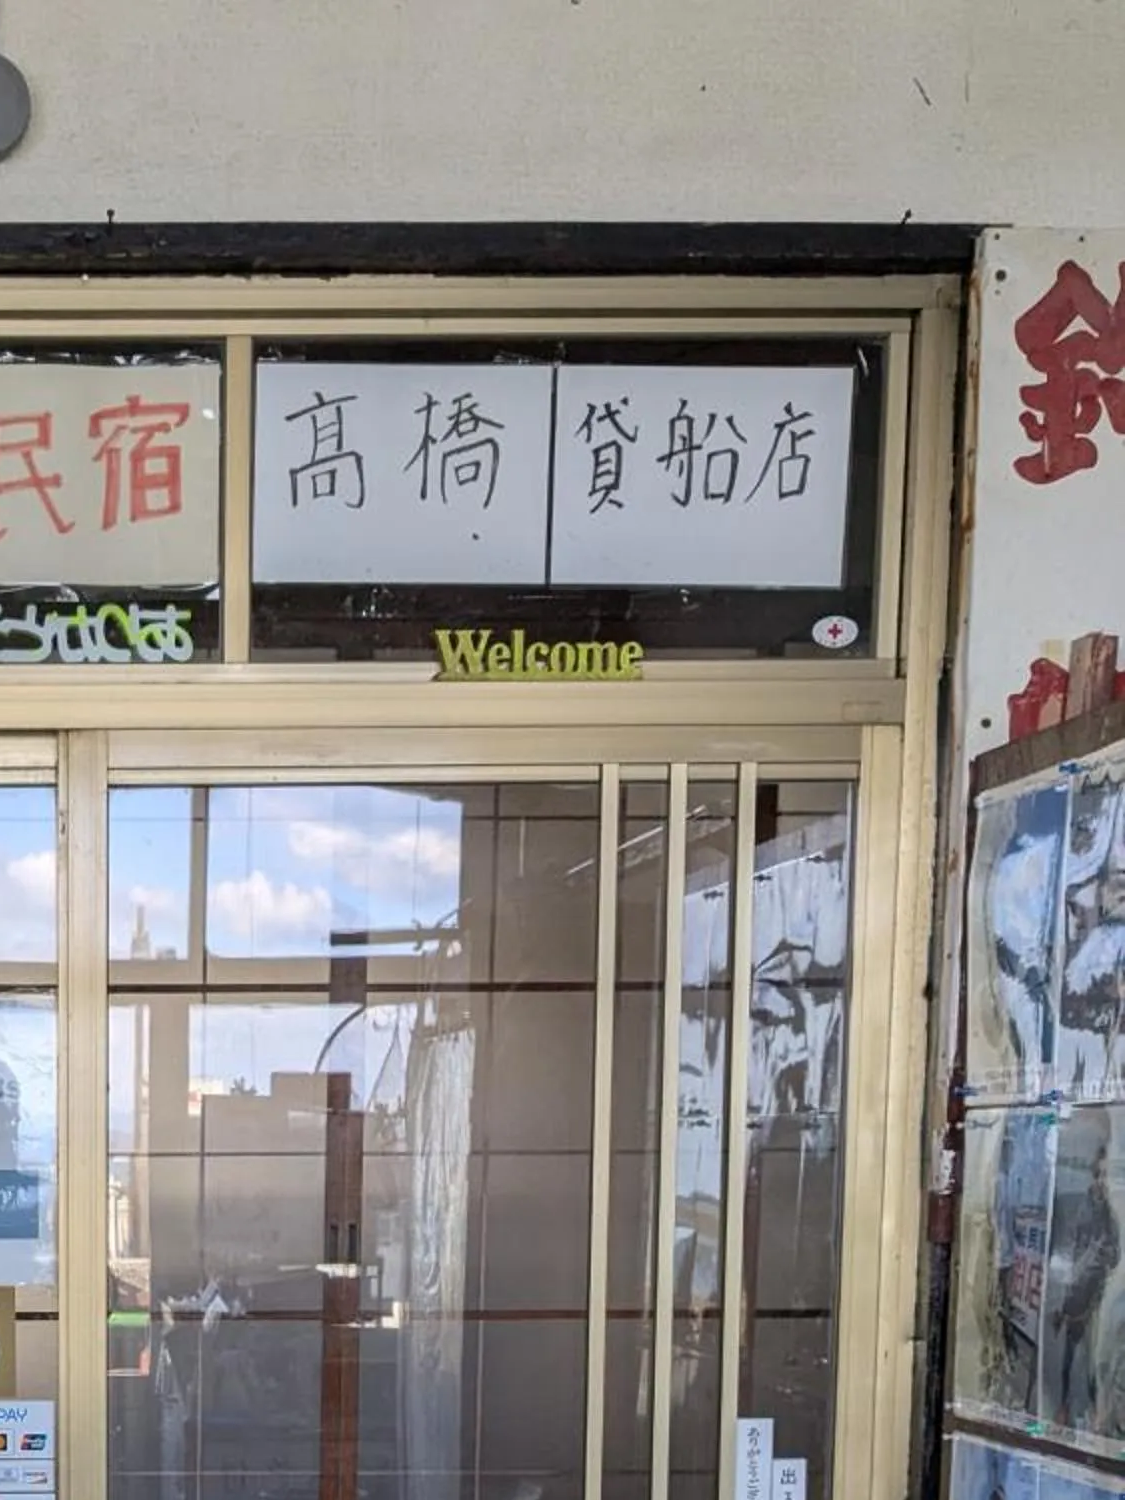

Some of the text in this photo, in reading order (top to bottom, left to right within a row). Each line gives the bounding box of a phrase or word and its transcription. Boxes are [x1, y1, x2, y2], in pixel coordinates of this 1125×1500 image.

[575, 396, 815, 514] 貸船店
[434, 627, 645, 681] Welcome
